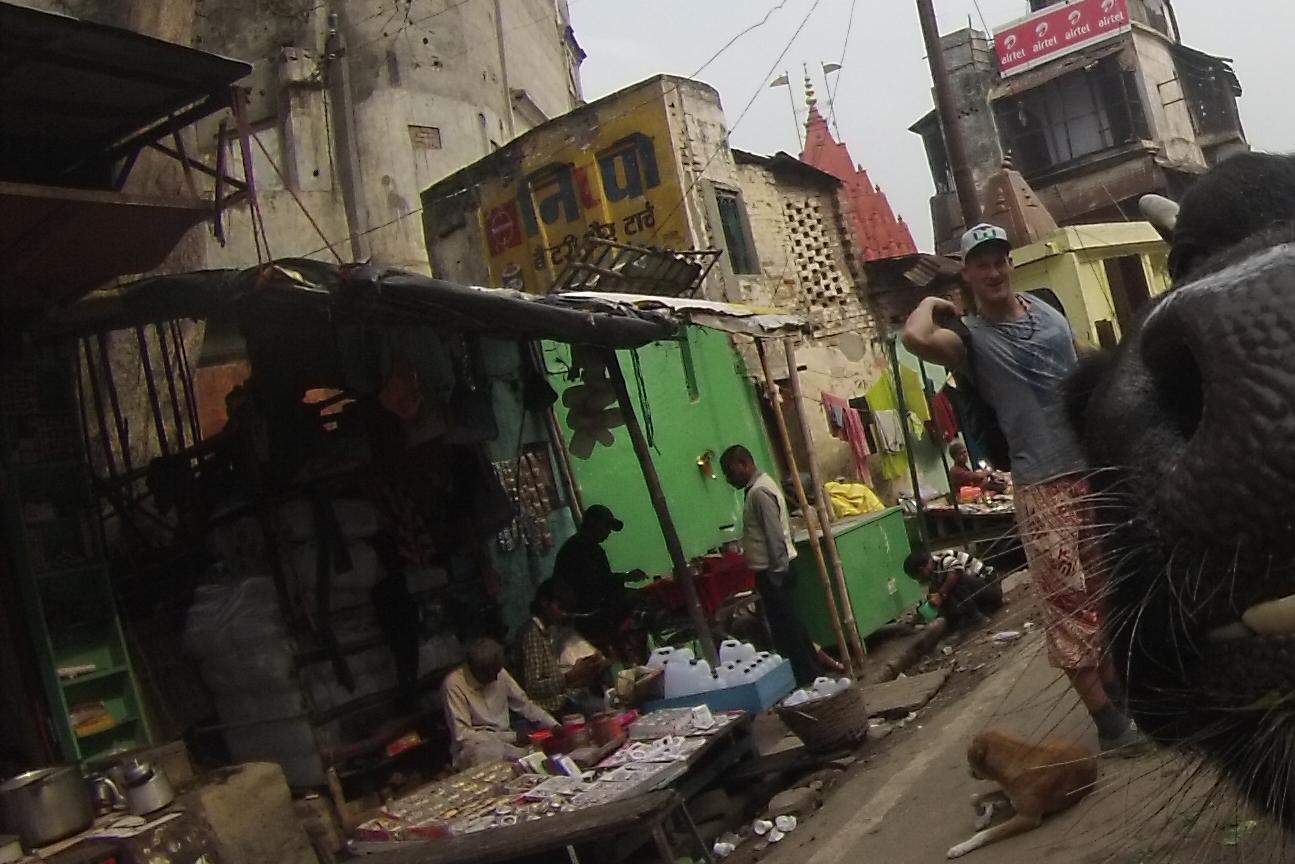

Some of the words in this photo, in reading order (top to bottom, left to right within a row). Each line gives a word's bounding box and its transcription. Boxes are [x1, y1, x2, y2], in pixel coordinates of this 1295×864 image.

[1098, 11, 1124, 28] airtel
[1065, 23, 1091, 40] airtel
[1032, 35, 1058, 53] airtel
[1001, 48, 1026, 65] airtel
